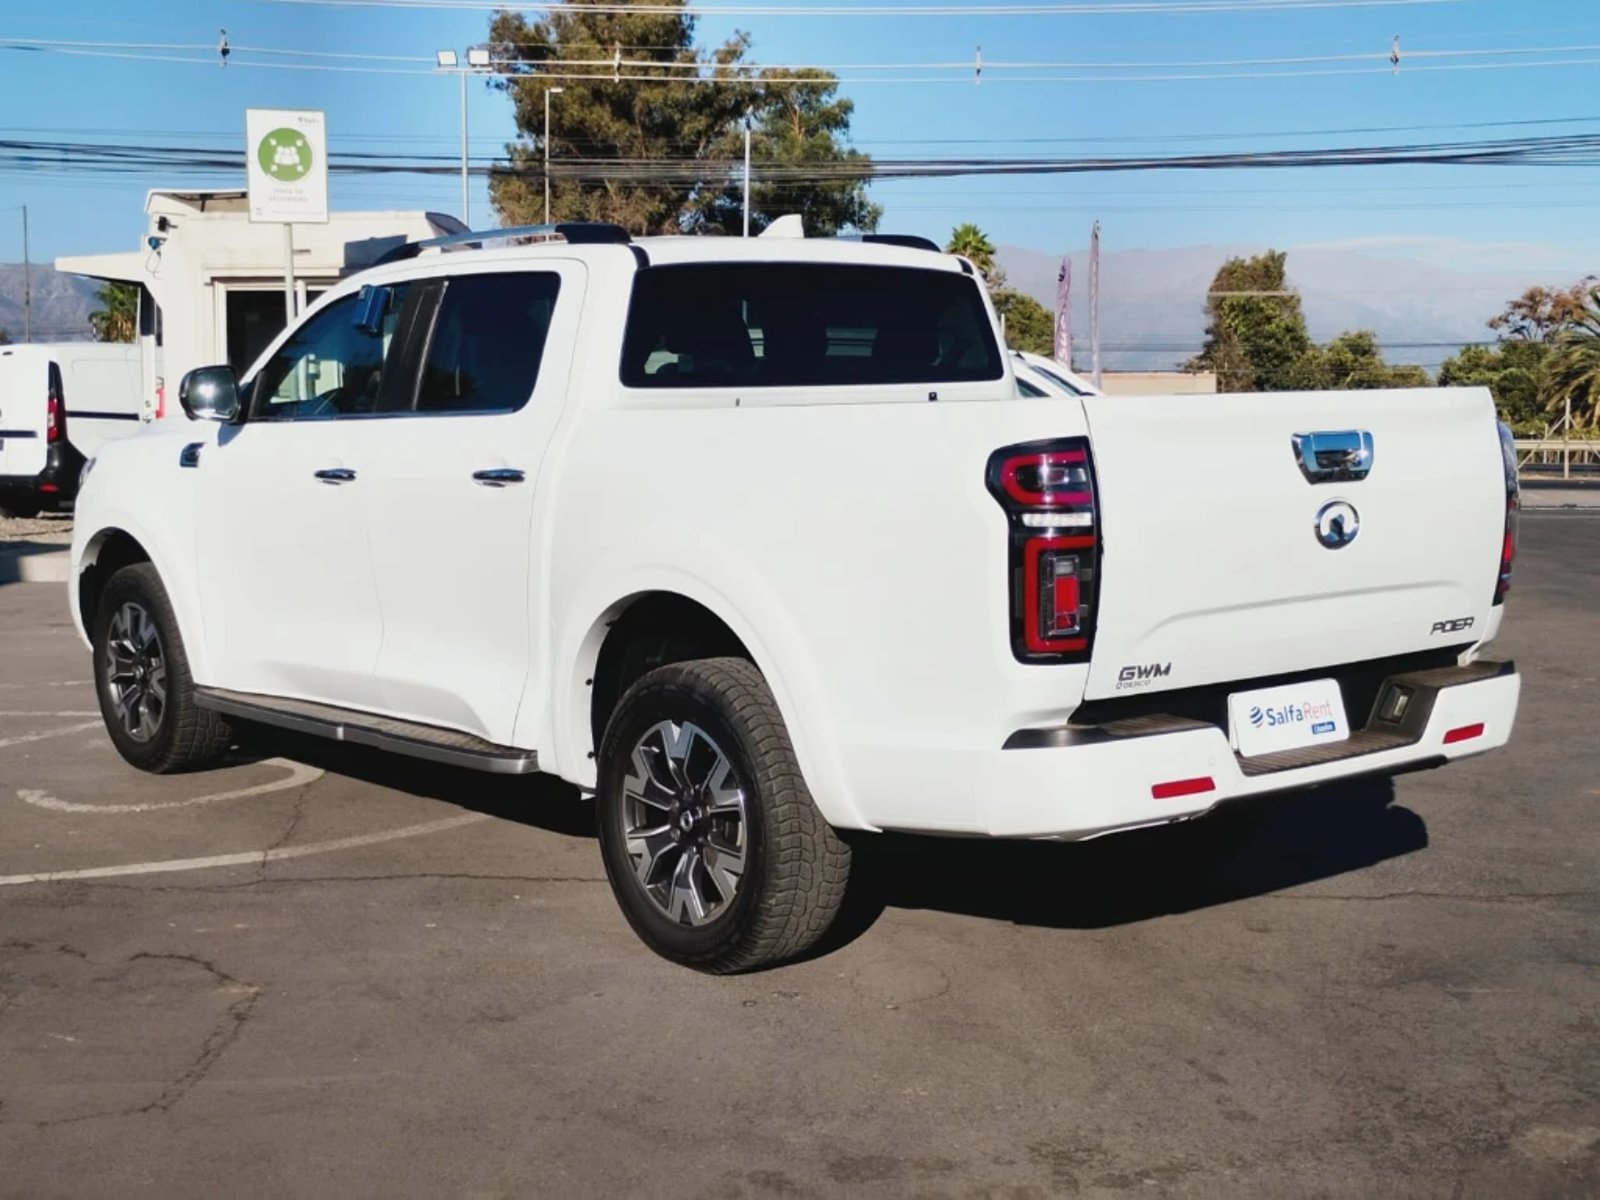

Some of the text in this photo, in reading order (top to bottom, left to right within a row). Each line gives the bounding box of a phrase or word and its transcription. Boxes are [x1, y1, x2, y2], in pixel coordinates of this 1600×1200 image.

[1430, 616, 1474, 635] POER
[1118, 662, 1171, 681] GWM
[1266, 701, 1333, 726] SalfaRent
